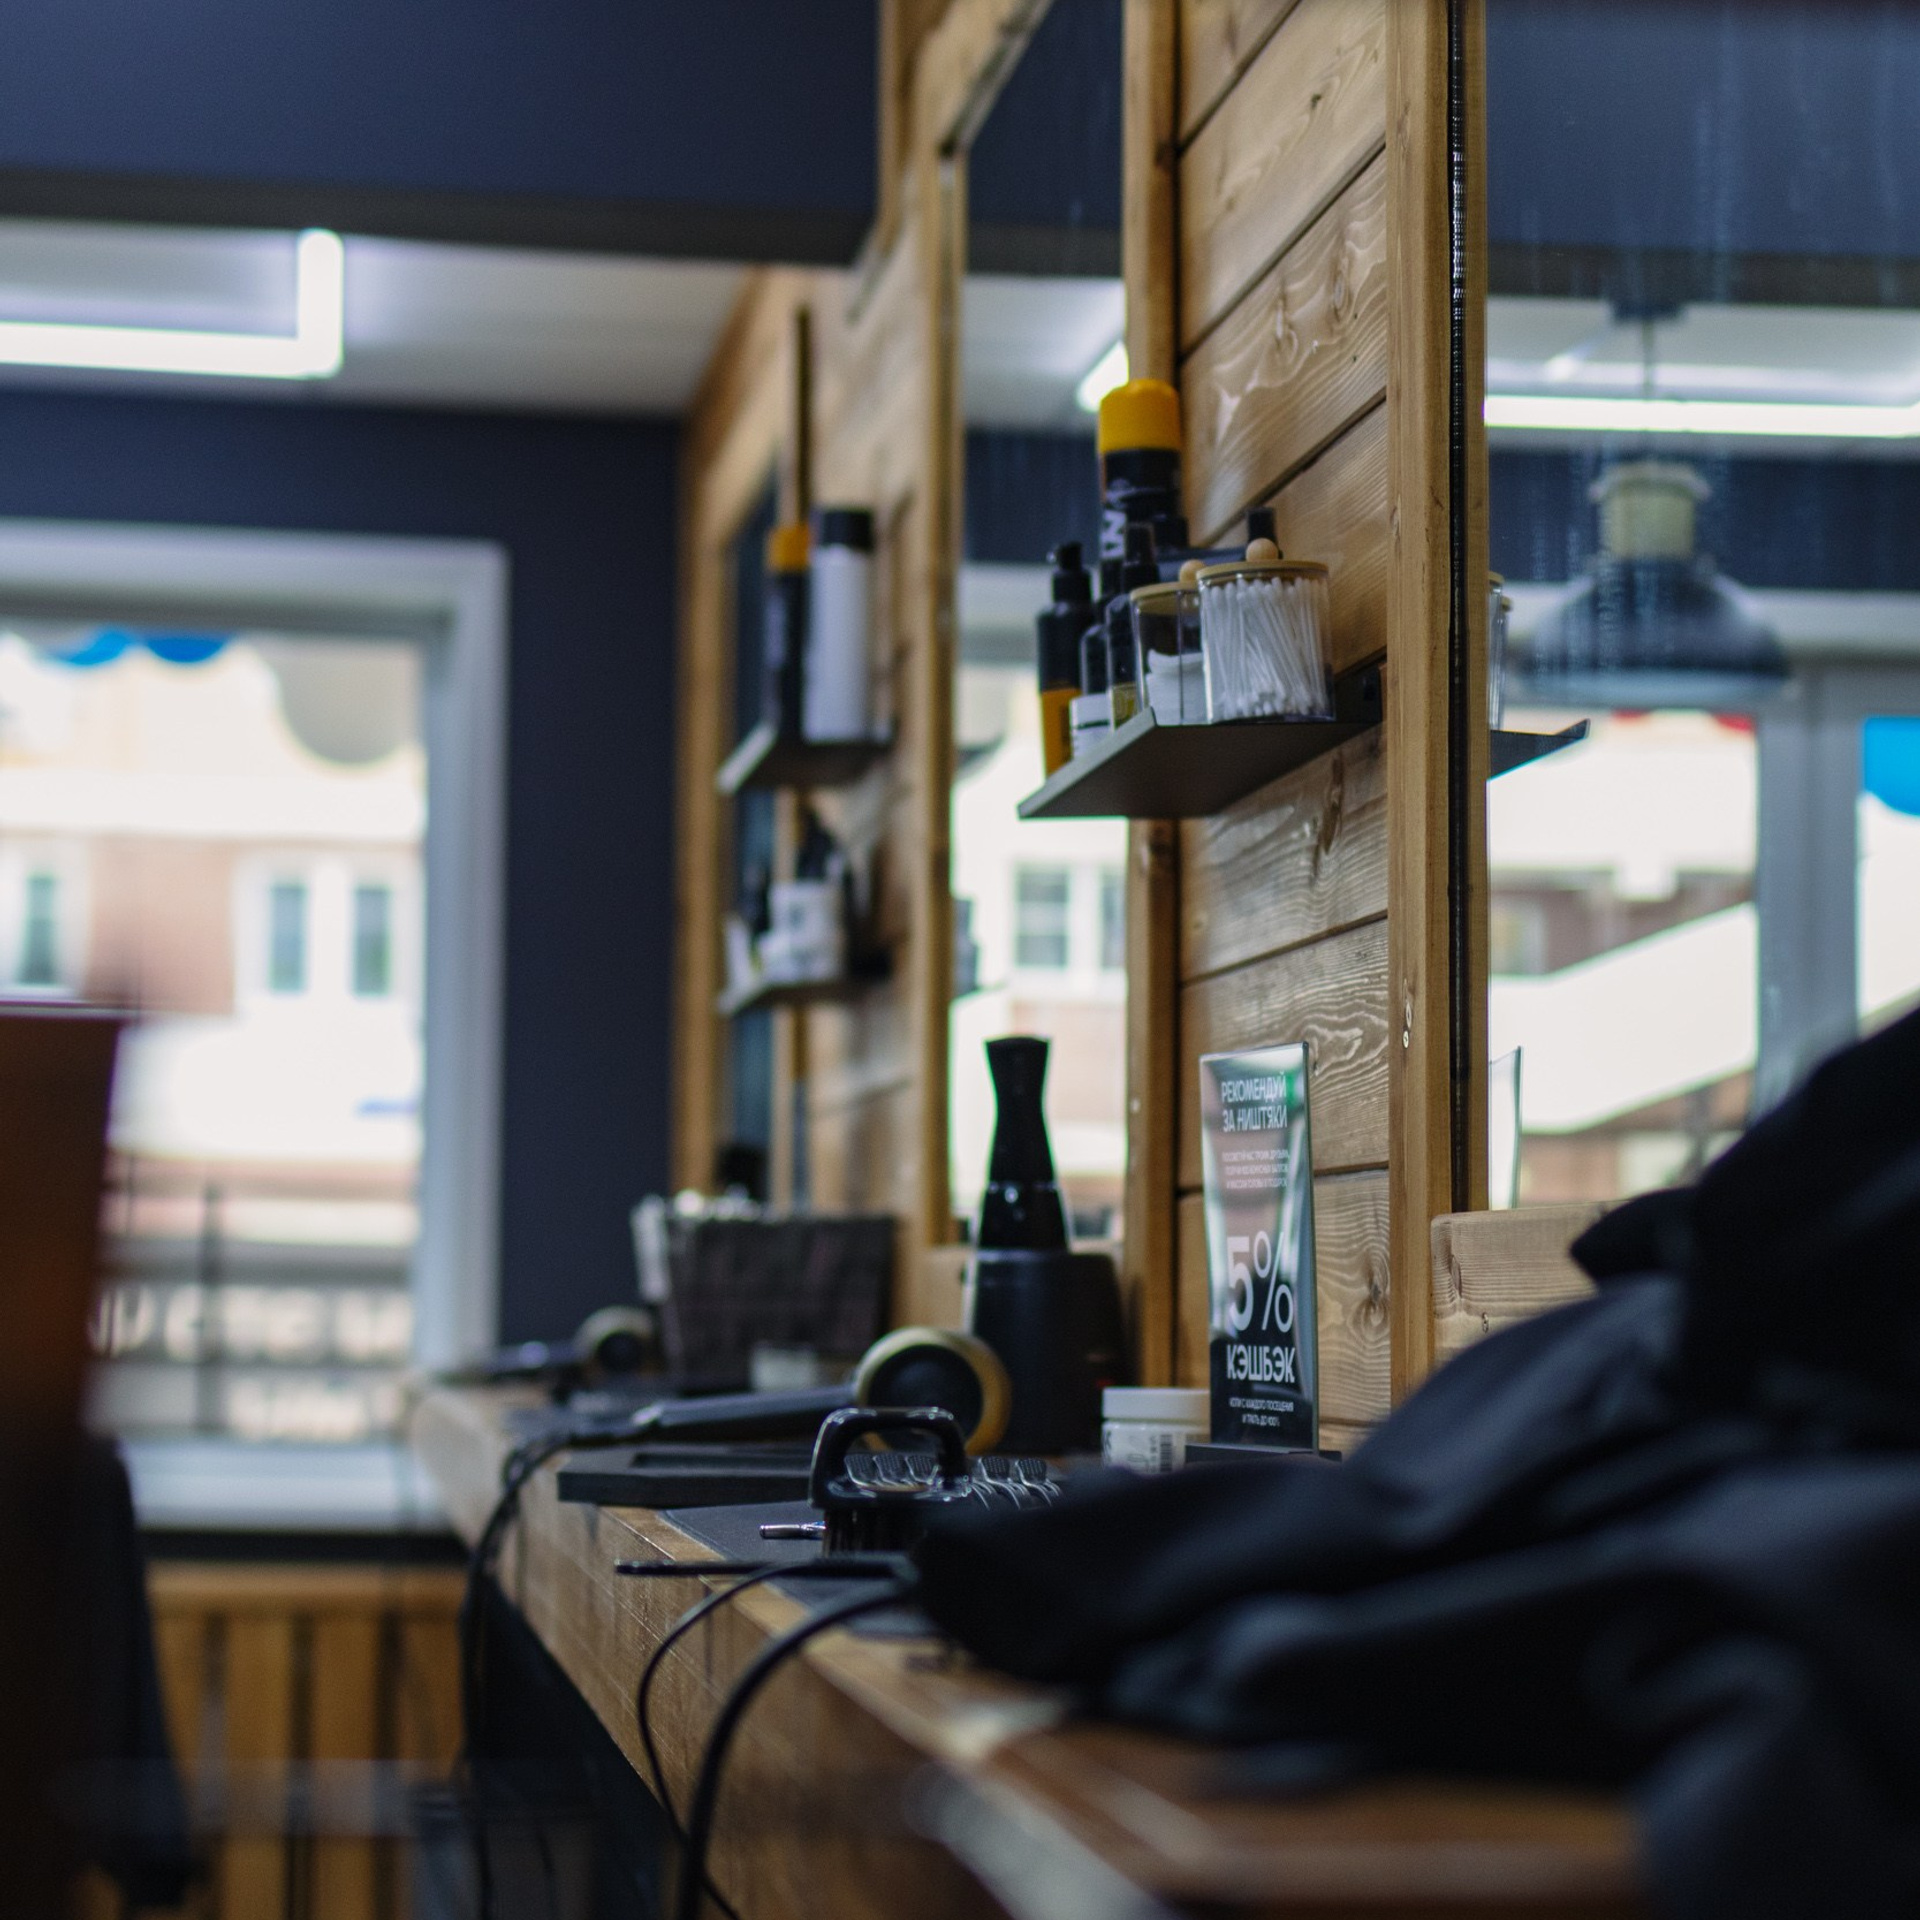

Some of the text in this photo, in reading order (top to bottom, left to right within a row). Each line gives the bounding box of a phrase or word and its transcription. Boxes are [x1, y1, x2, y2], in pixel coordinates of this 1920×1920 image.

[1221, 1070, 1287, 1103] РЕКОМЕНДУЙ
[1223, 1104, 1287, 1132] ЗА НИШТЯКИ
[1227, 1230, 1293, 1333] 5%
[1226, 1344, 1295, 1383] КЭШБЭК
